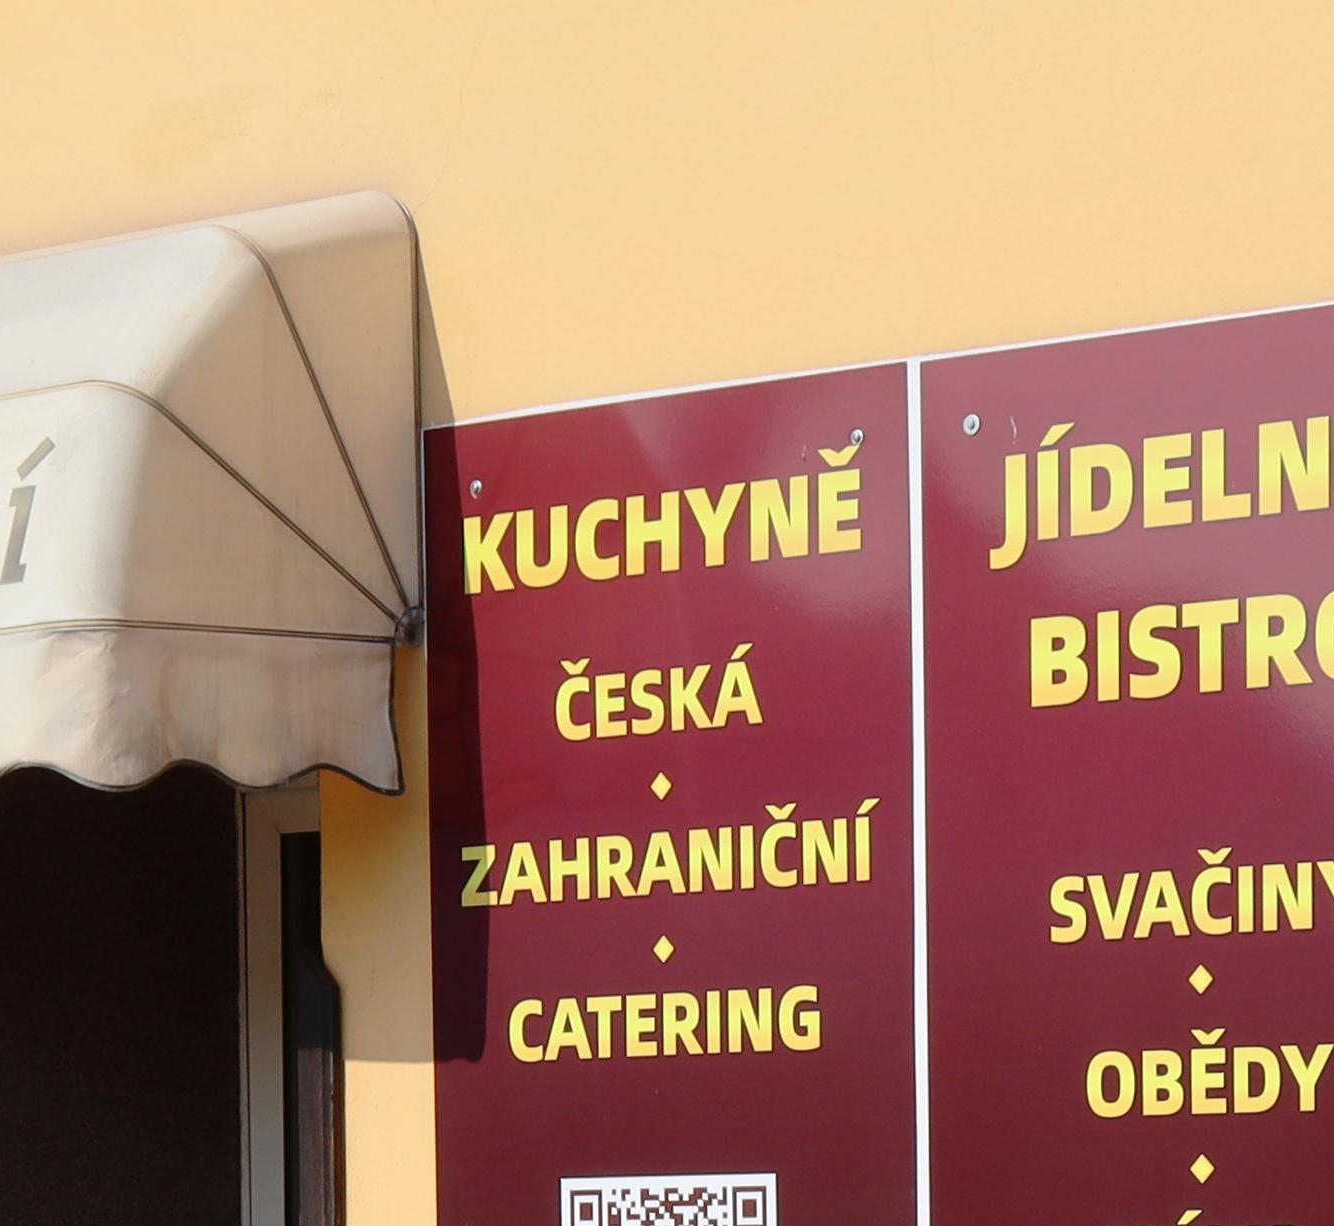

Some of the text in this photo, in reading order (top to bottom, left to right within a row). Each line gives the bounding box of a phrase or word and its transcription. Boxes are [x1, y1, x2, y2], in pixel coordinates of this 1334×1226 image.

[464, 445, 863, 593] KUCHYNĚ
[556, 644, 762, 740] ČESKÁ
[462, 797, 879, 906] ZAHRANIČNÍ
[510, 986, 820, 1061] CATERING
[1087, 1029, 1334, 1117] OBĚDY
